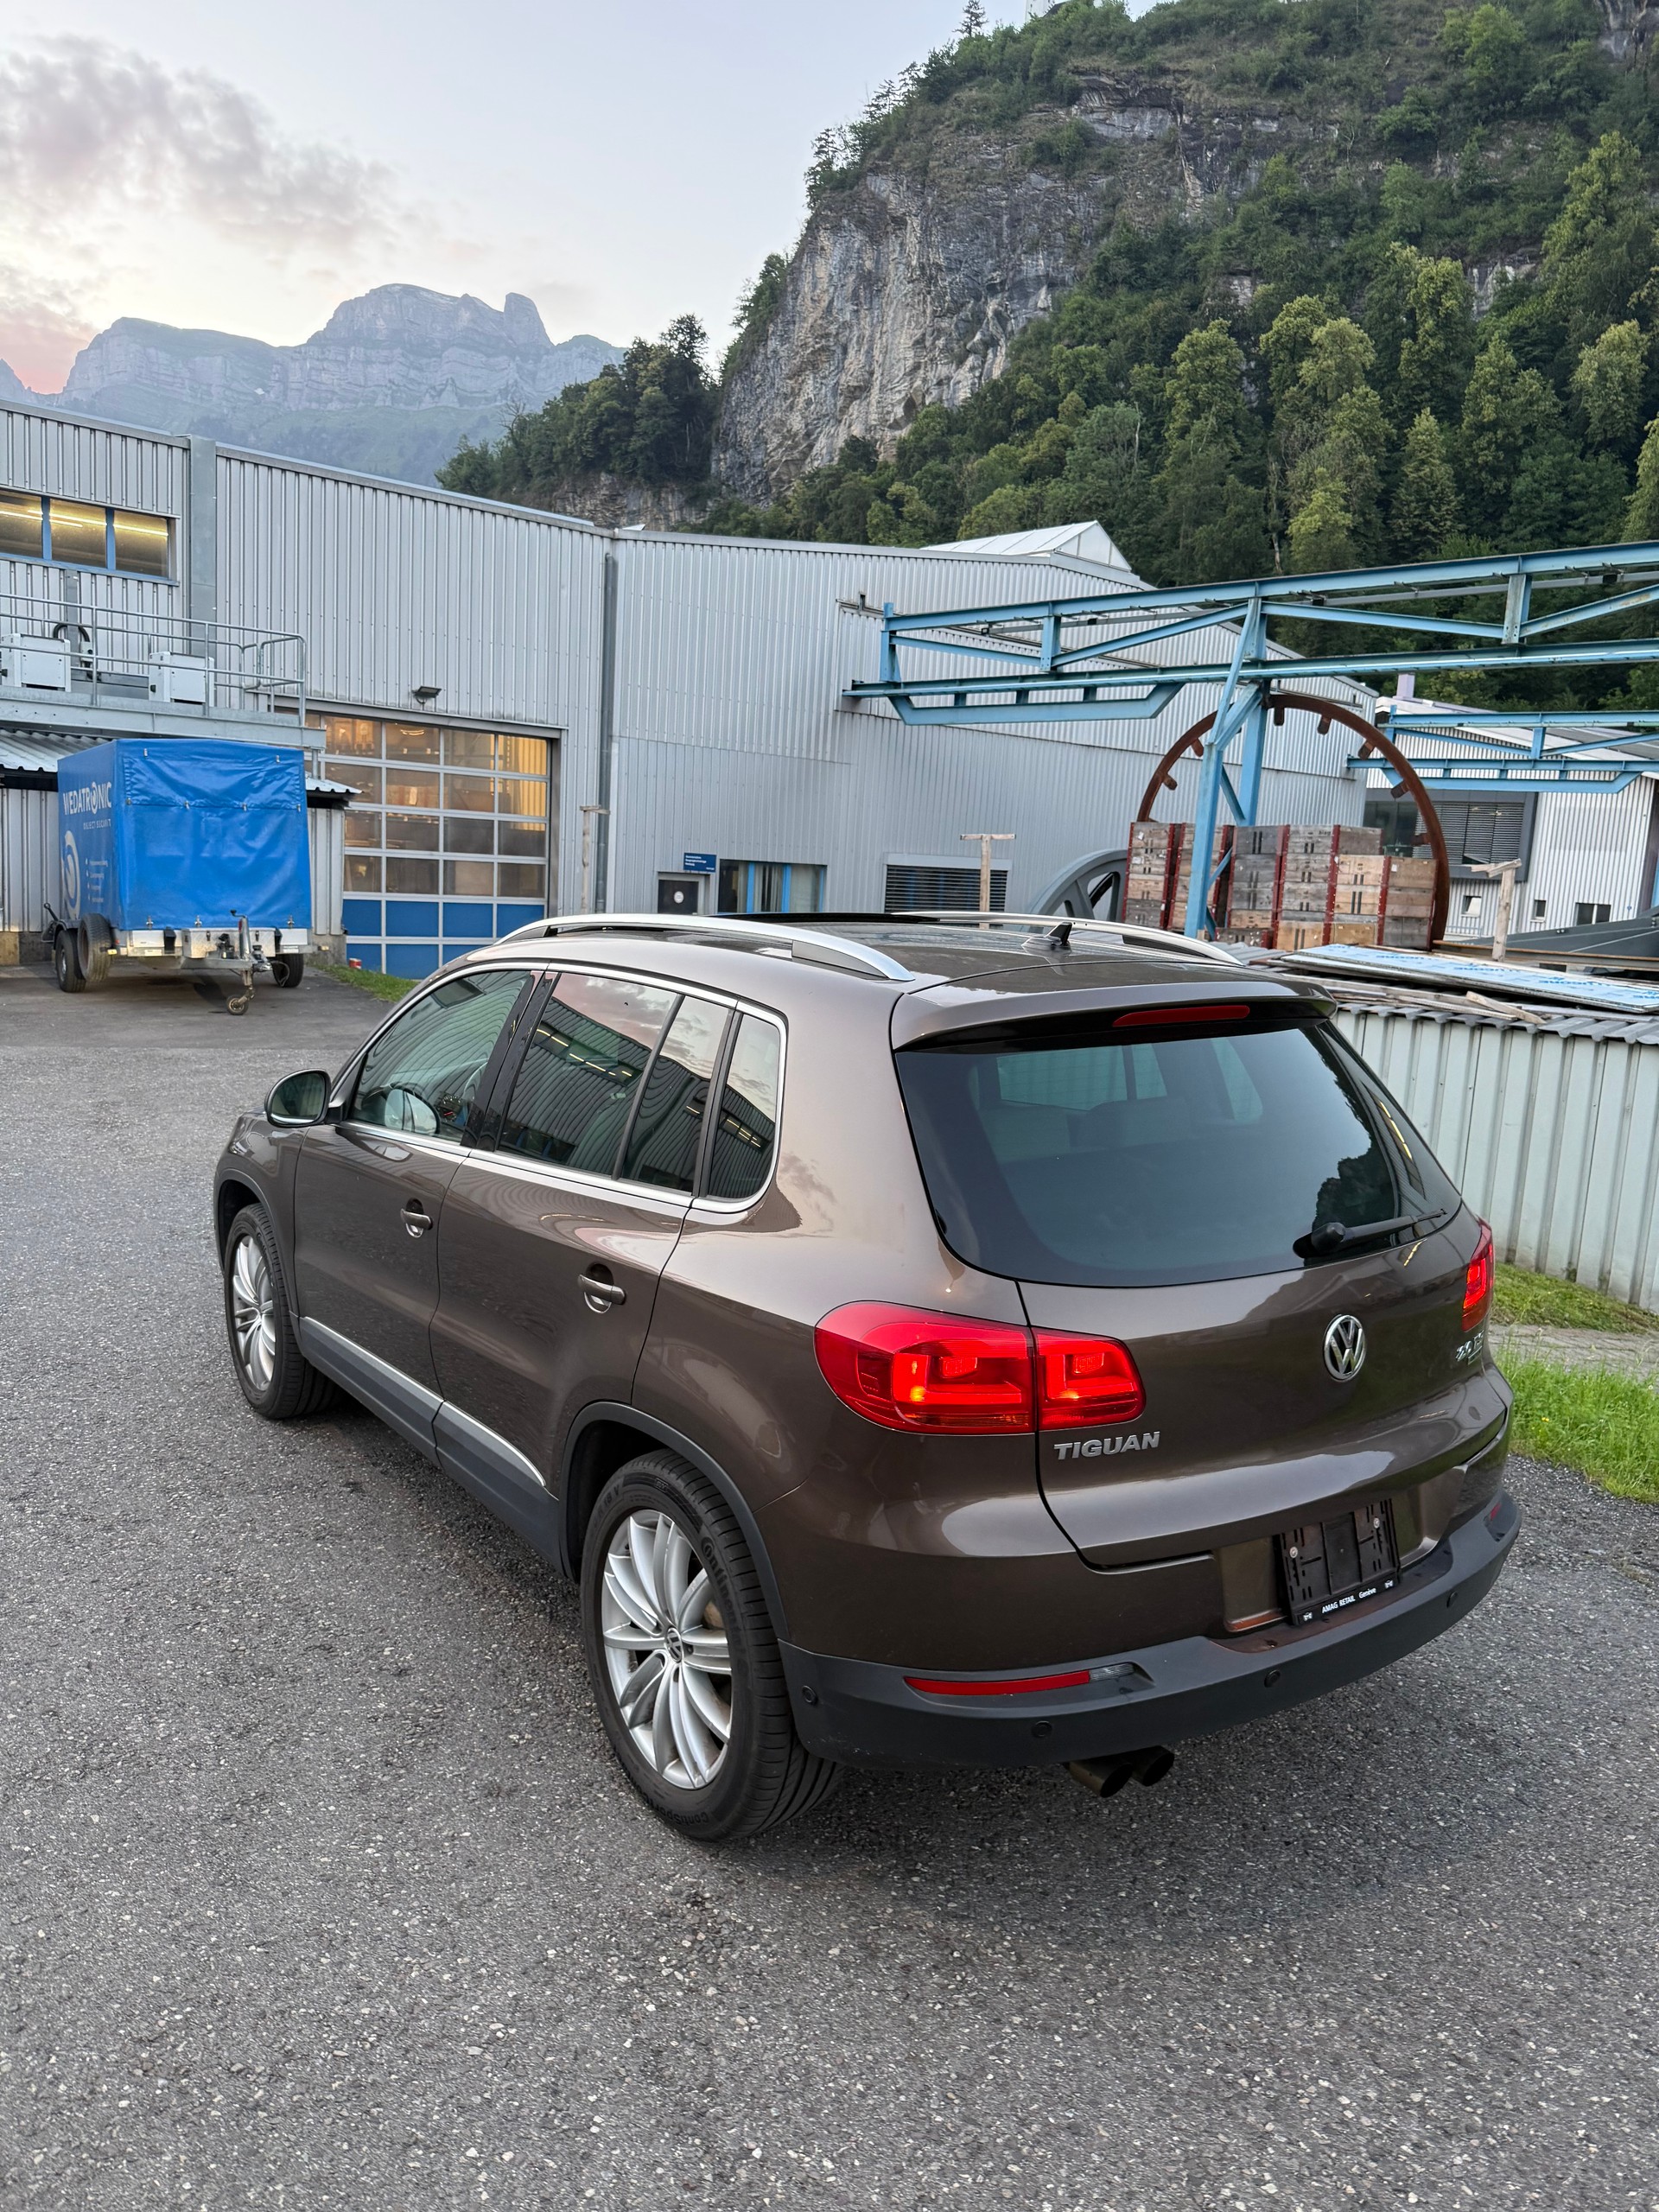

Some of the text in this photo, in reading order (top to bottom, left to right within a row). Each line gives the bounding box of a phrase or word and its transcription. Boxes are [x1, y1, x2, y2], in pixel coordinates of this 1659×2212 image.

[63, 781, 112, 816] WEDATRONIC
[1053, 1431, 1160, 1460] TIGUAN
[700, 1535, 746, 1654] Continental
[1321, 1601, 1338, 1614] AMAG
[1338, 1595, 1356, 1607] RETAIL
